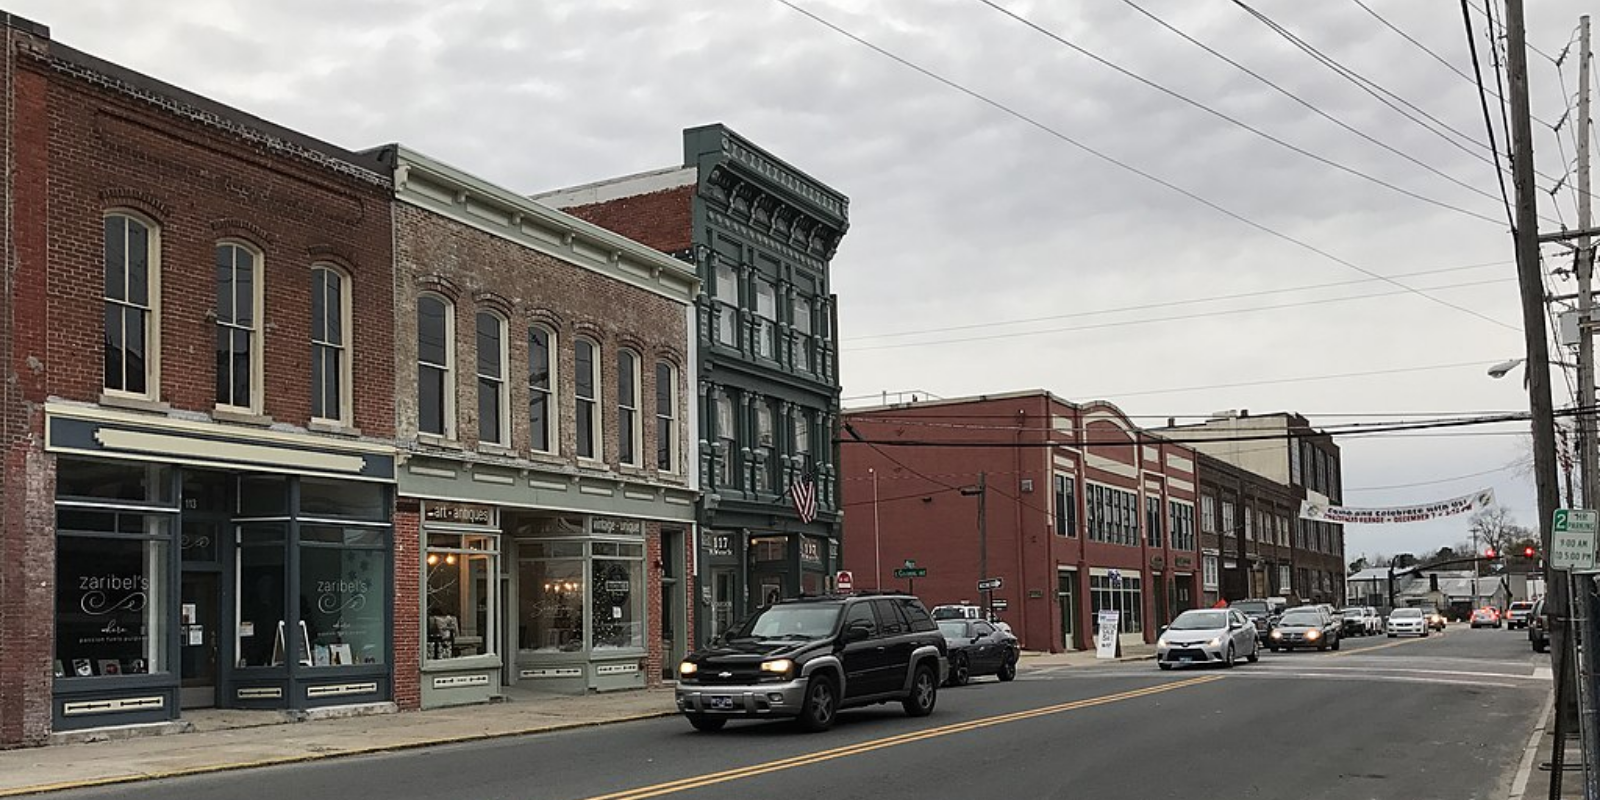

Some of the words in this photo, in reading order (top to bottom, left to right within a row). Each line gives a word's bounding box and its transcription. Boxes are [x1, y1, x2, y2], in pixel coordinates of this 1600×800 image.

[434, 505, 447, 518] art
[453, 507, 489, 523] antiques
[1556, 513, 1566, 529] 2
[1569, 521, 1594, 531] PARKING
[713, 537, 728, 548] 117
[1560, 539, 1576, 548] 9:00
[1577, 539, 1588, 548] AM
[1564, 551, 1580, 560] 5:00
[1582, 552, 1592, 560] PM
[79, 574, 150, 590] zaribel's
[317, 579, 368, 593] zaribel's
